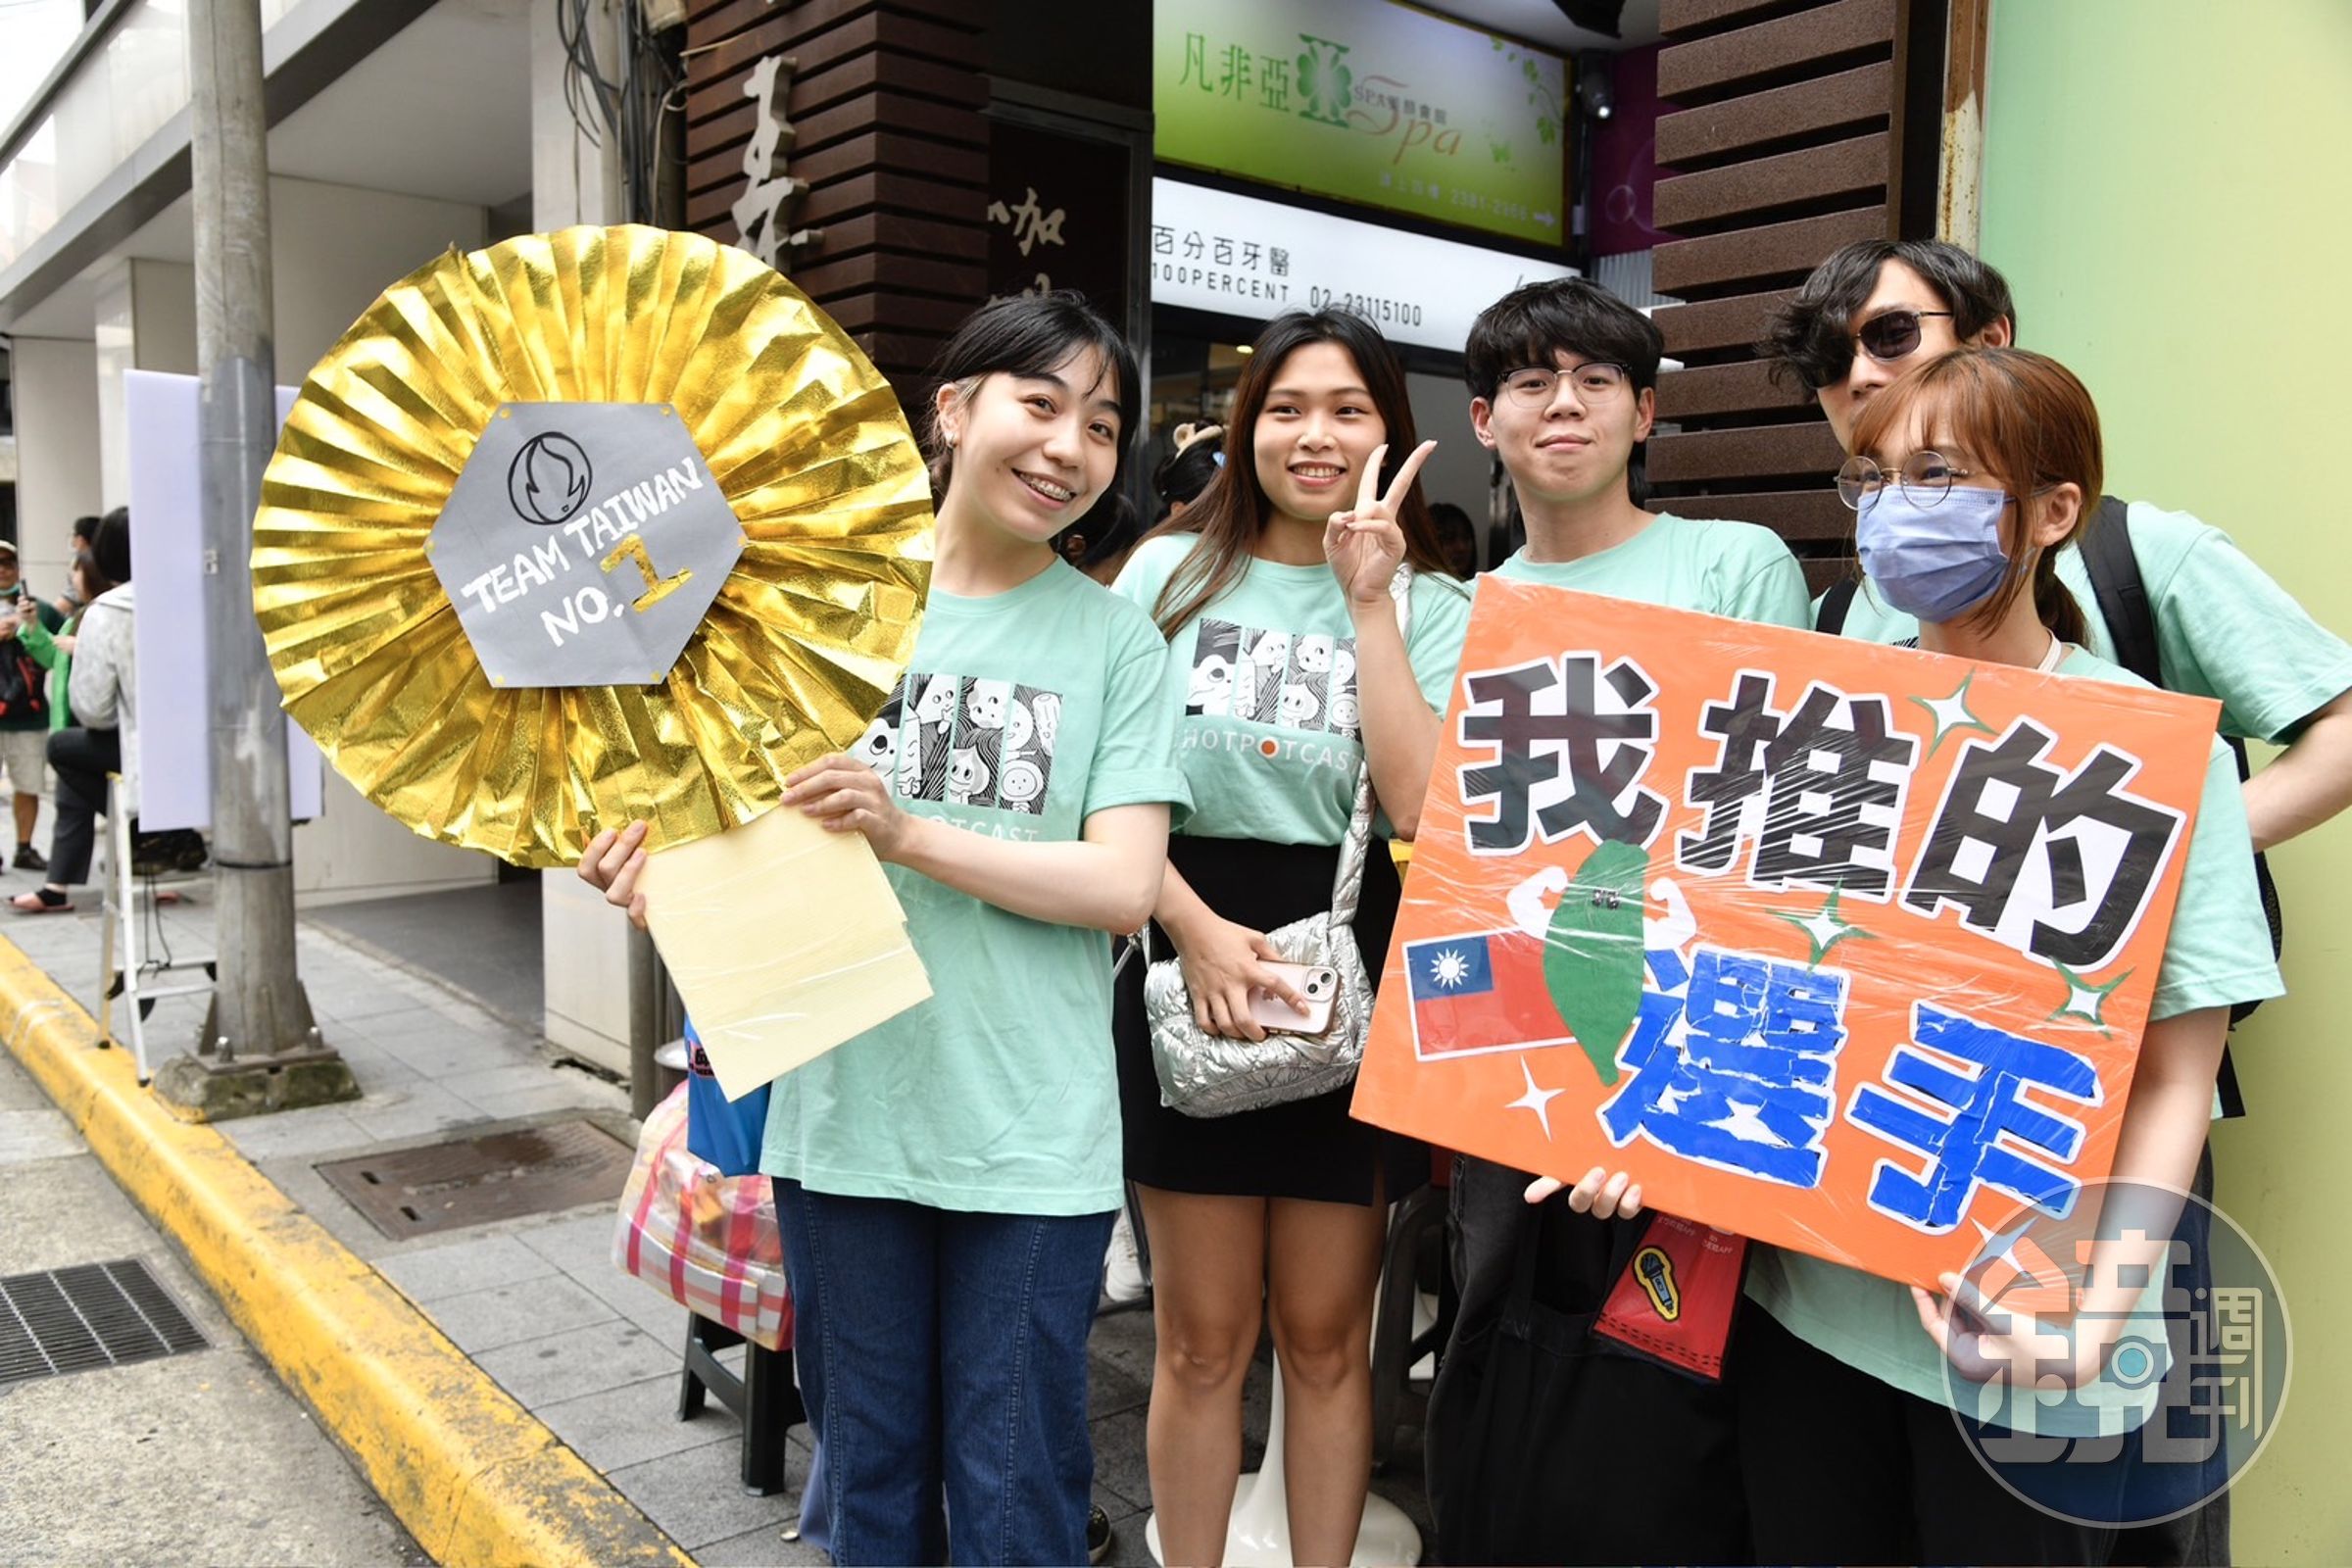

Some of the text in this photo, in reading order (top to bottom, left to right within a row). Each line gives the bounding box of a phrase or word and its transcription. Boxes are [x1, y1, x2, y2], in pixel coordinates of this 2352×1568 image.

[1179, 32, 1291, 113] 凡非亞
[1152, 262, 1290, 303] 100PERCENT
[1309, 285, 1332, 311] 02
[461, 456, 704, 613] TEAM TAIWAN
[1459, 655, 2183, 969] 我推的
[1601, 945, 2100, 1232] 選手
